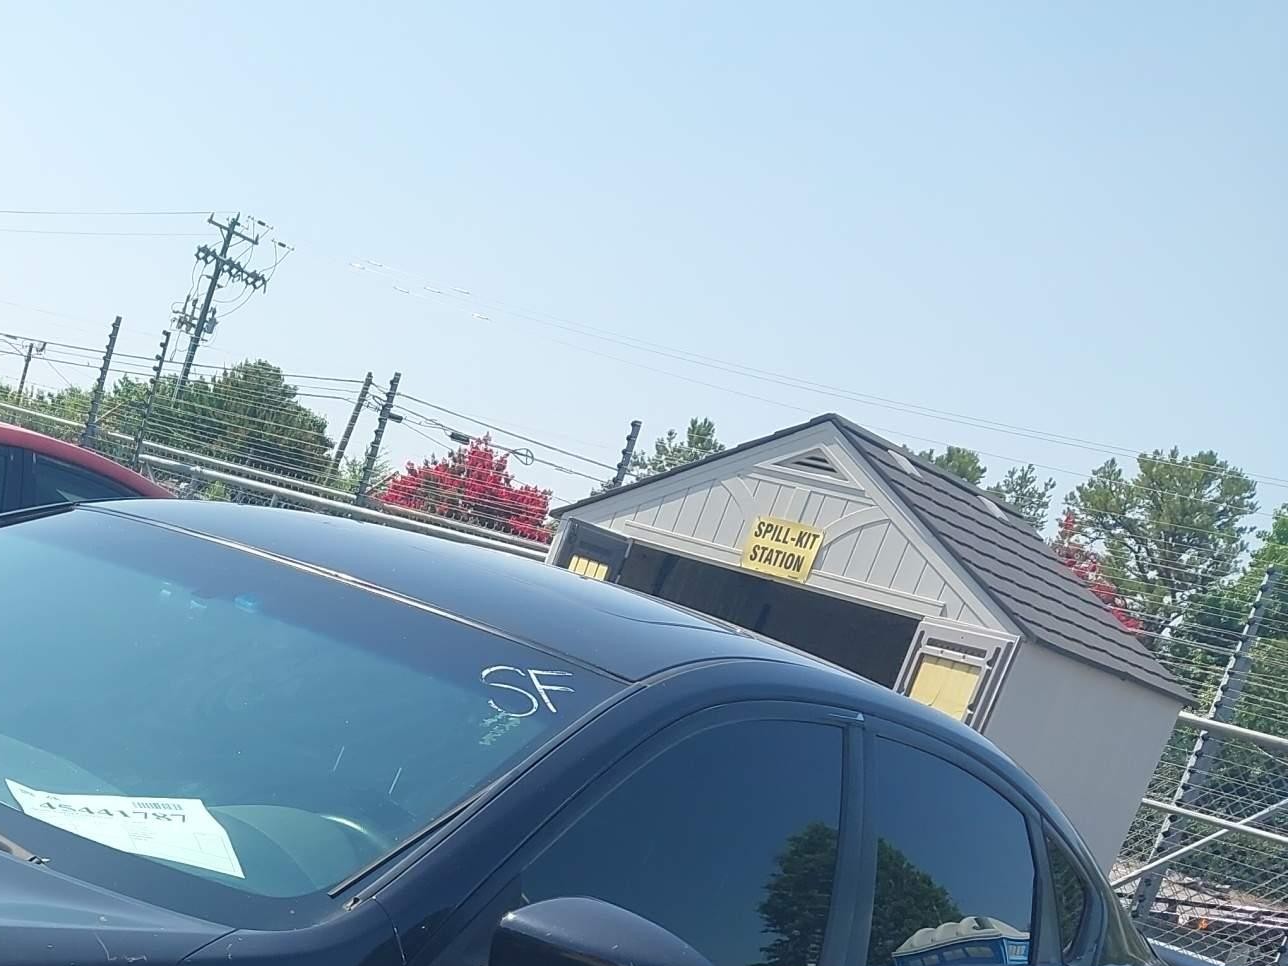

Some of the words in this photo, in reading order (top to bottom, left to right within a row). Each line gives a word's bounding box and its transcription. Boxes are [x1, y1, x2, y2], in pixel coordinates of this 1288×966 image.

[754, 521, 820, 550] SPILL-KIT
[749, 544, 805, 572] STATION
[481, 665, 575, 718] SF
